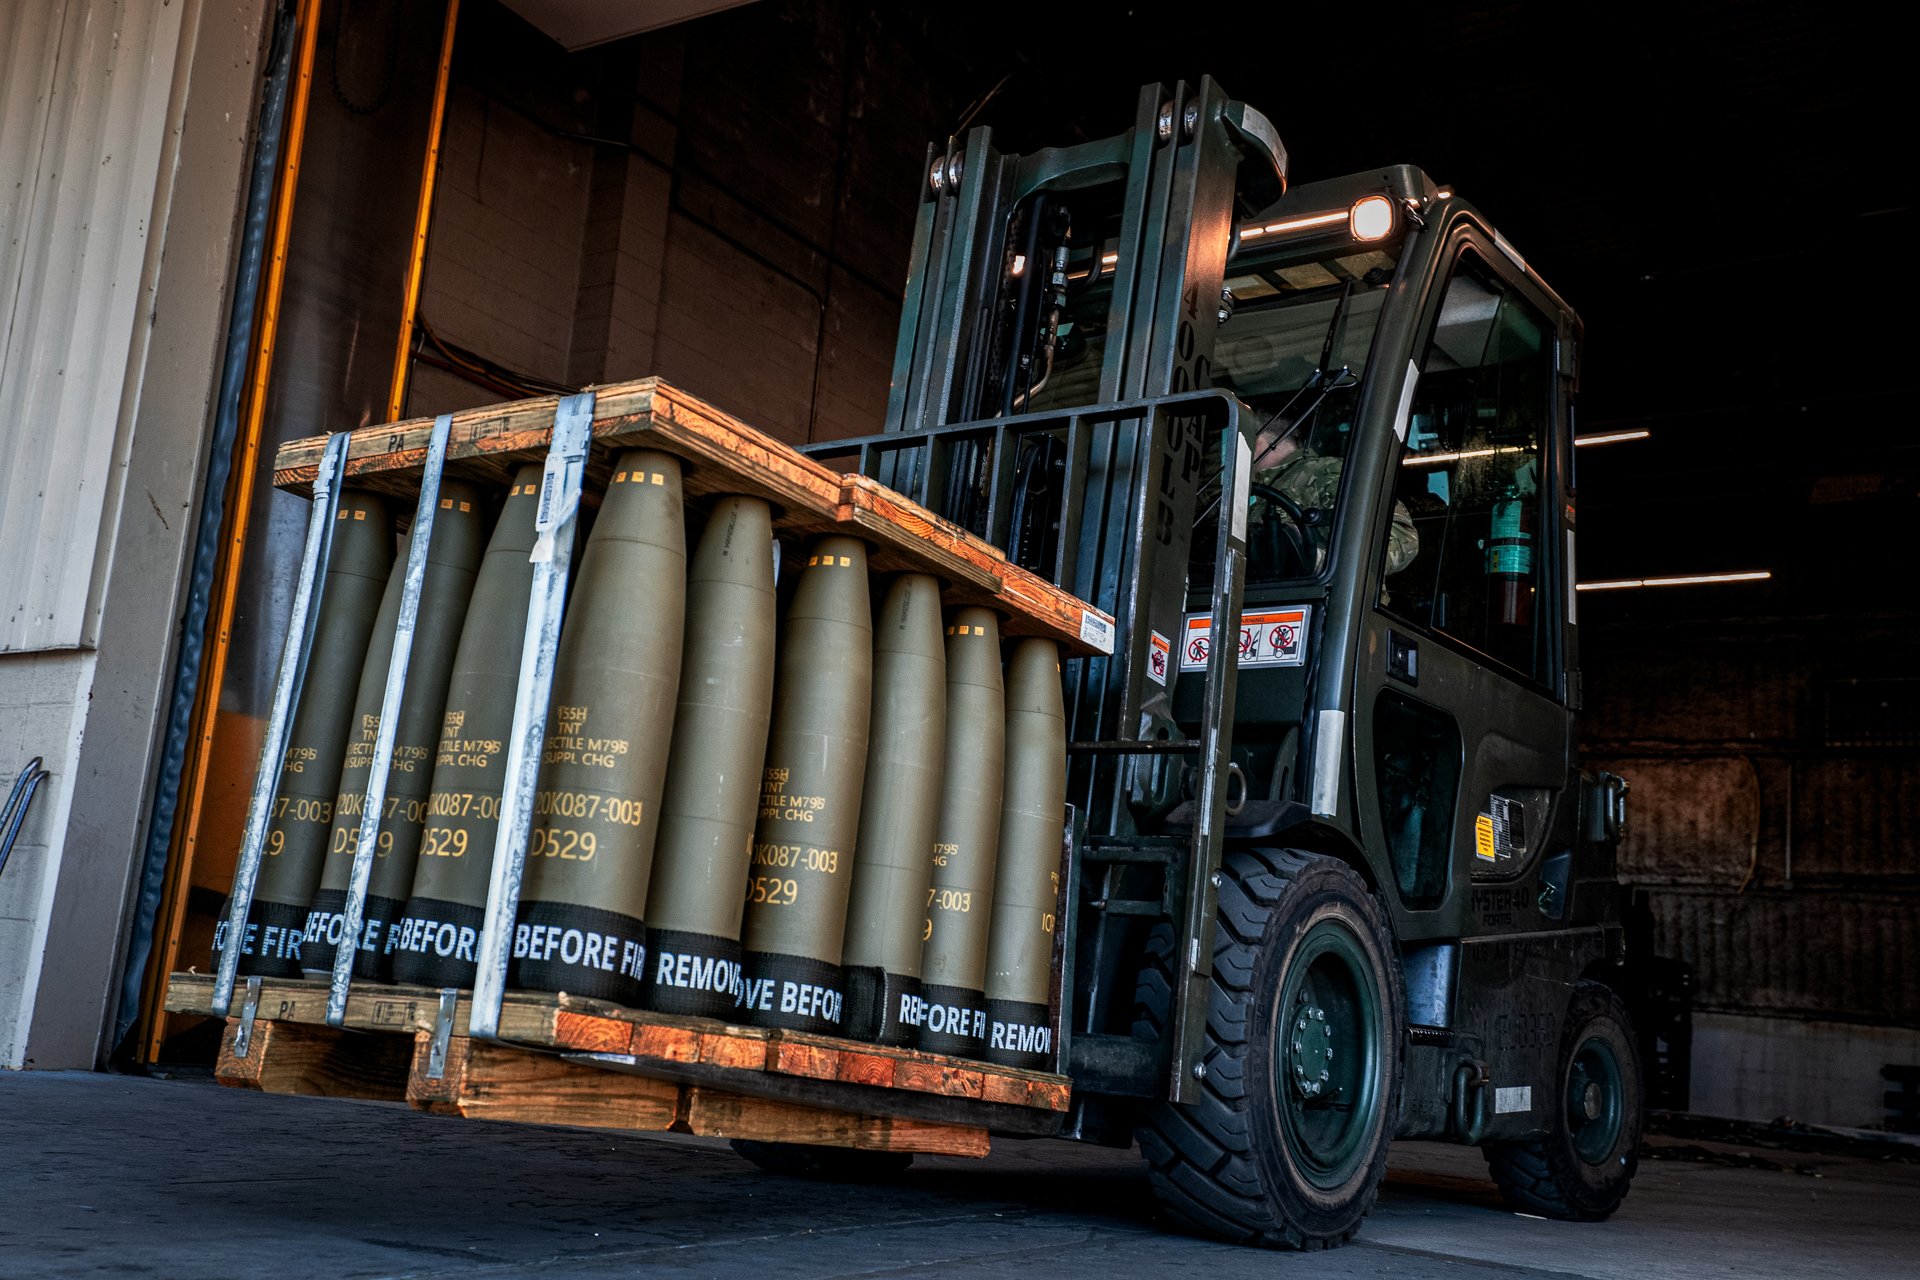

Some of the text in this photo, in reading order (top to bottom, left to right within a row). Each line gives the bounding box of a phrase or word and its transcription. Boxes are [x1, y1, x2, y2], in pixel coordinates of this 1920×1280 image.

[388, 433, 405, 452] PA
[1241, 616, 1265, 625] ARNING
[558, 721, 583, 735] TNT
[463, 740, 502, 755] M795
[587, 739, 629, 755] M795
[458, 754, 488, 768] CHG
[582, 753, 616, 768] CHG
[764, 782, 785, 794] TNT
[789, 796, 826, 811] M795
[784, 809, 814, 823] CHG
[532, 828, 597, 862] D529
[1483, 912, 1512, 926] FORTIS
[513, 923, 618, 972] BEFORE
[278, 1000, 297, 1021] PA
